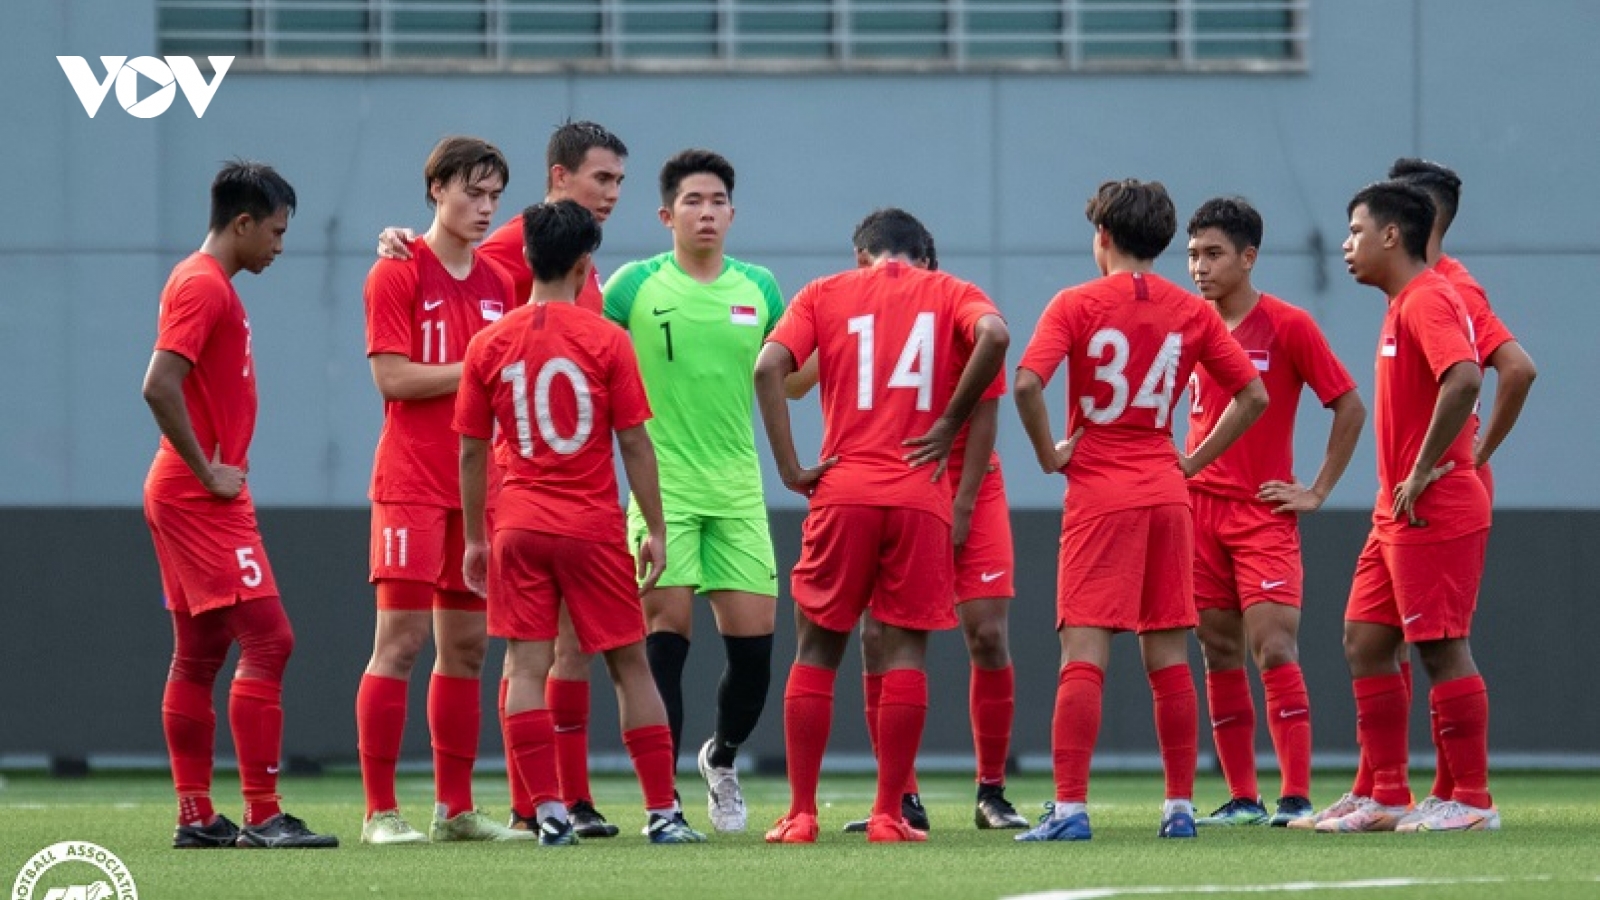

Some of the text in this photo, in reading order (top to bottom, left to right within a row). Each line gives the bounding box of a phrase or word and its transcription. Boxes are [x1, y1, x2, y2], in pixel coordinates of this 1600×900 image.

[421, 319, 446, 363] 11
[660, 321, 673, 362] 1
[847, 311, 936, 412] 14
[1079, 327, 1184, 429] 34
[501, 357, 594, 459] 10
[235, 547, 262, 588] 5
[382, 527, 408, 567] 11
